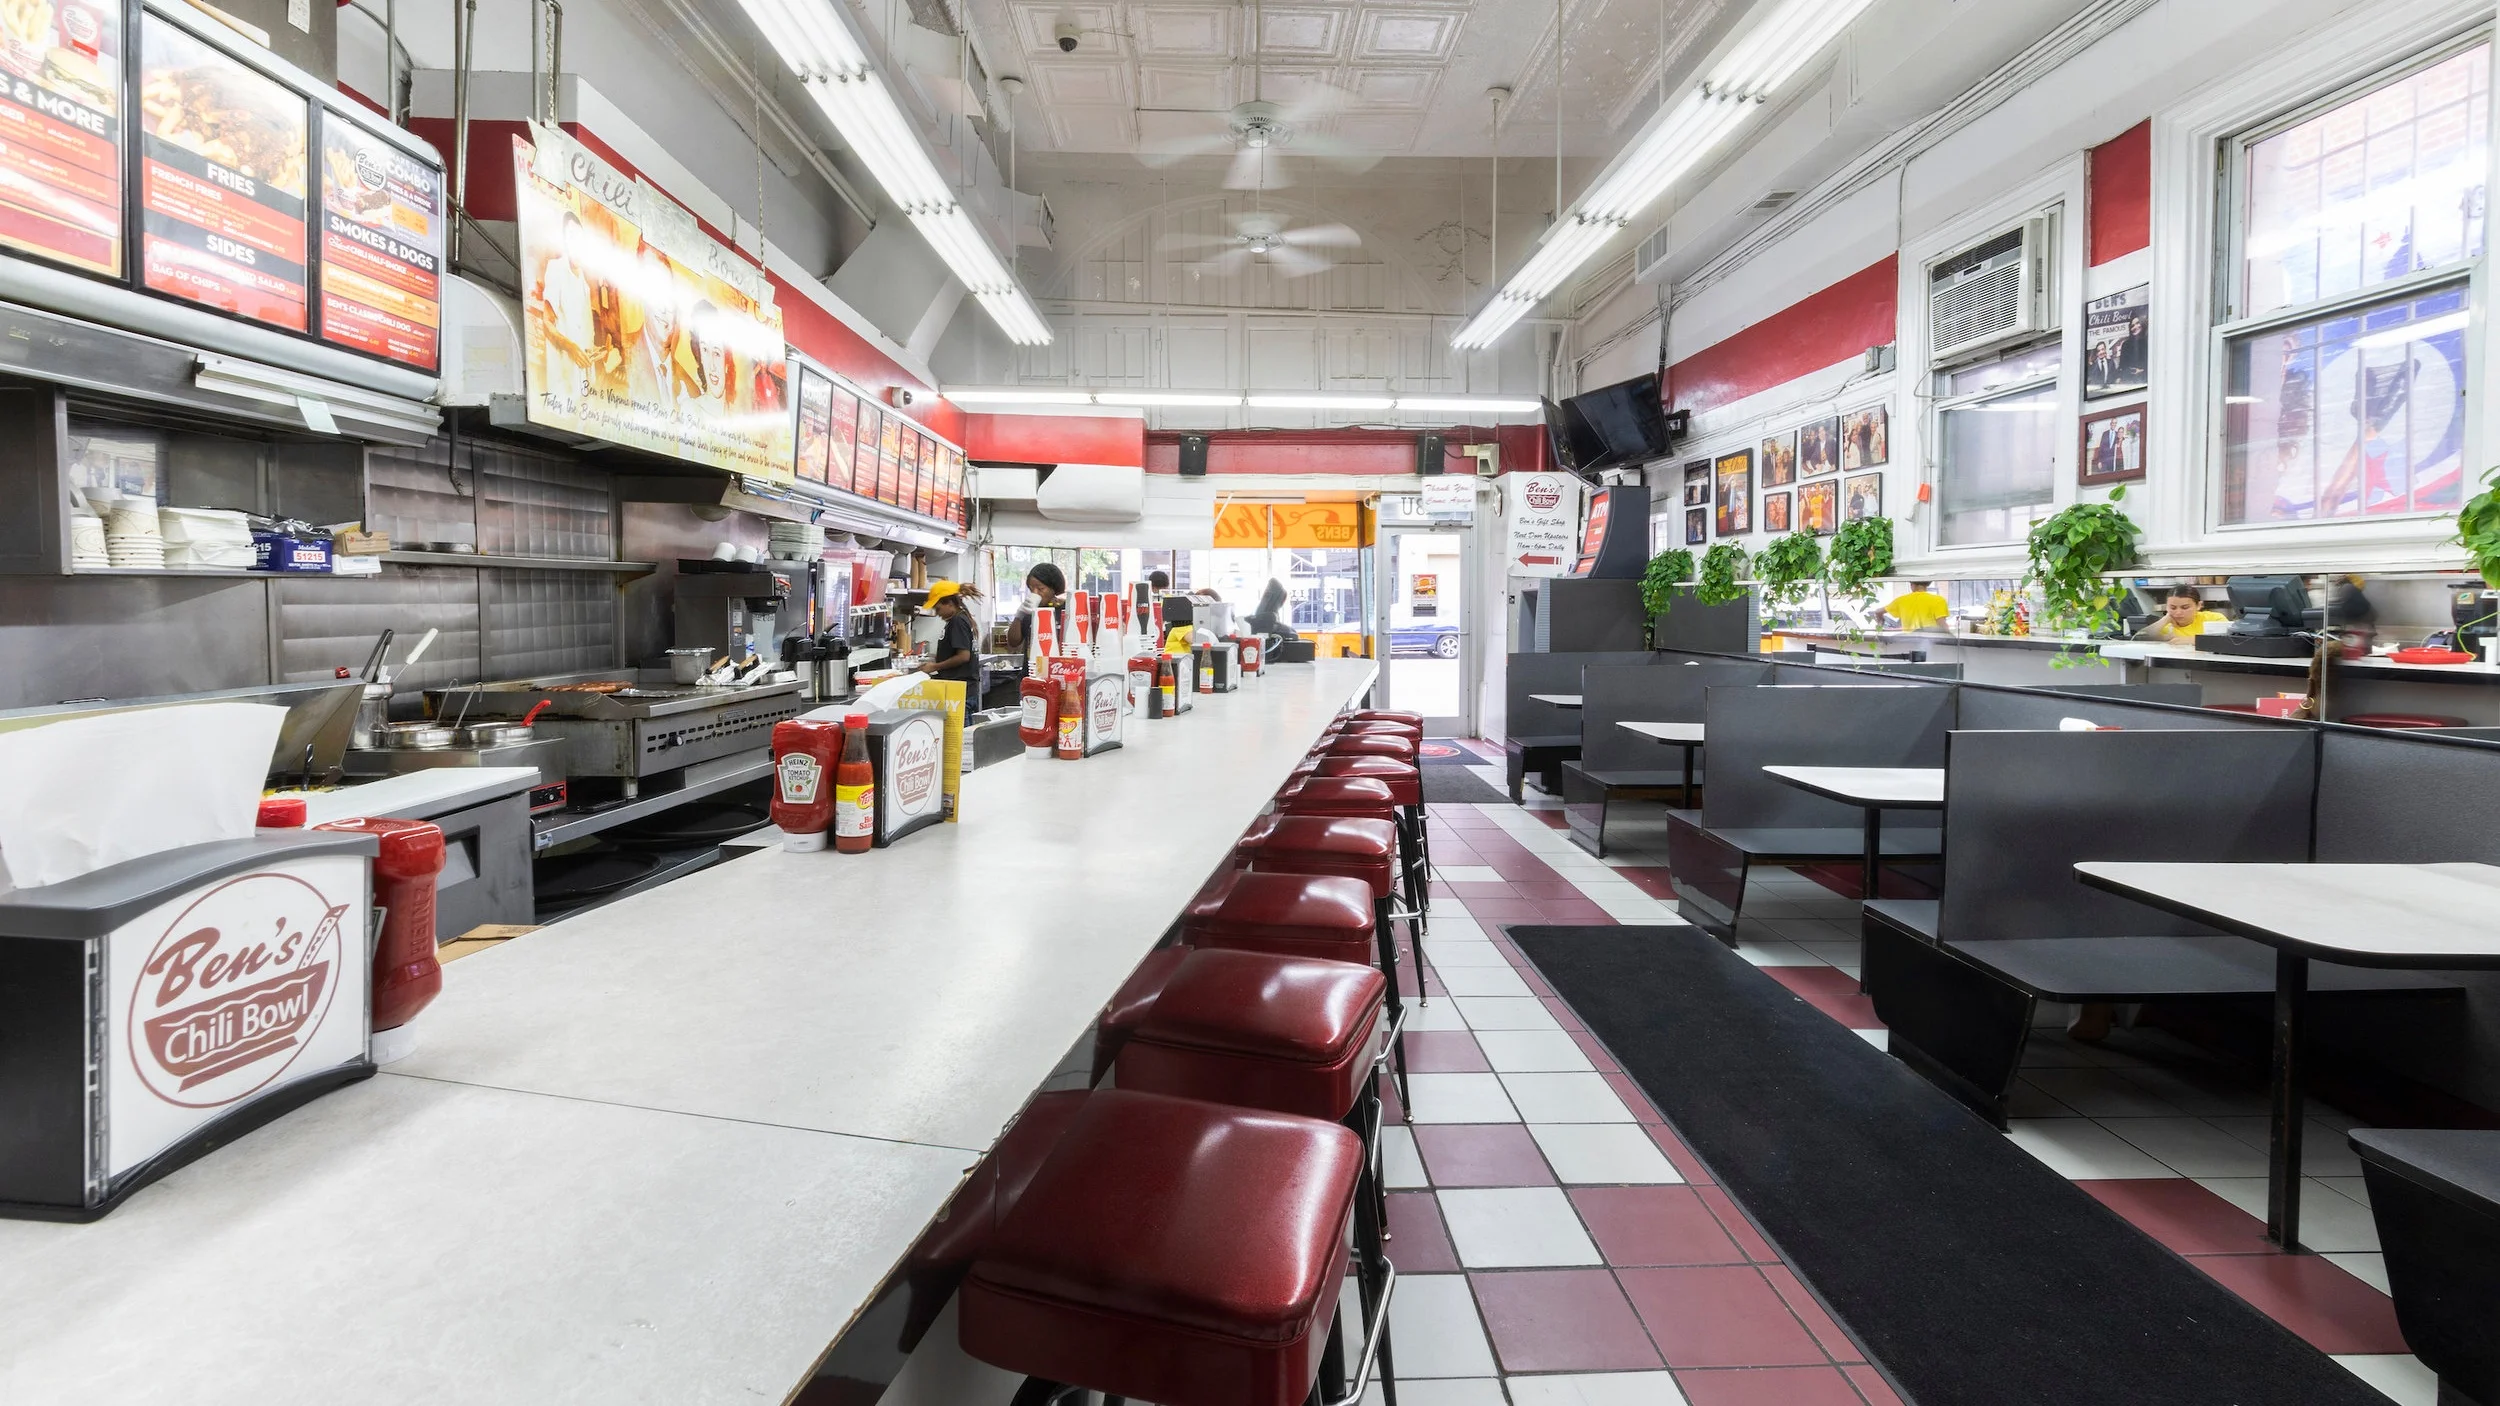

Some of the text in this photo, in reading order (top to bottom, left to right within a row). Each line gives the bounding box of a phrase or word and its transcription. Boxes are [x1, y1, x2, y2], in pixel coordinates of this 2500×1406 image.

[13, 81, 33, 105] &
[37, 90, 105, 136] MORE
[151, 165, 223, 201] FRENCH FRIES
[207, 162, 256, 197] FRIES
[387, 160, 431, 193] COMBO
[570, 151, 635, 218] Chili
[206, 234, 256, 266] SIDES
[330, 215, 387, 251] SMOKES
[387, 240, 398, 256] &
[400, 245, 433, 270] DOGS
[350, 246, 368, 260] CHILI
[367, 252, 408, 275] HALF-SMOKE
[708, 243, 748, 290] Bow
[151, 262, 174, 277] BAG
[175, 269, 191, 282] OF
[191, 274, 221, 292] CHIPS
[258, 275, 286, 292] SALAD
[327, 297, 348, 312] BEN'S
[396, 321, 412, 332] DOG
[2088, 310, 2133, 326] Chili Bowl
[2089, 325, 2126, 337] THE FAMOUS
[580, 379, 598, 398] Ben
[539, 391, 563, 415] Today
[1526, 481, 1555, 493] Ben's
[1519, 516, 1566, 527] Ben's Gift Shop
[1591, 501, 1609, 520] ATM
[1513, 531, 1569, 540] Next Door Upstairs
[1548, 542, 1565, 551] Daily
[296, 552, 323, 562] 51215
[899, 697, 941, 709] TORY
[1093, 691, 1113, 710] Ben's
[788, 758, 809, 767] HEINZ
[895, 738, 929, 770] Ben's
[147, 916, 303, 1008] Ben's
[165, 984, 309, 1064] Chili Bowl
